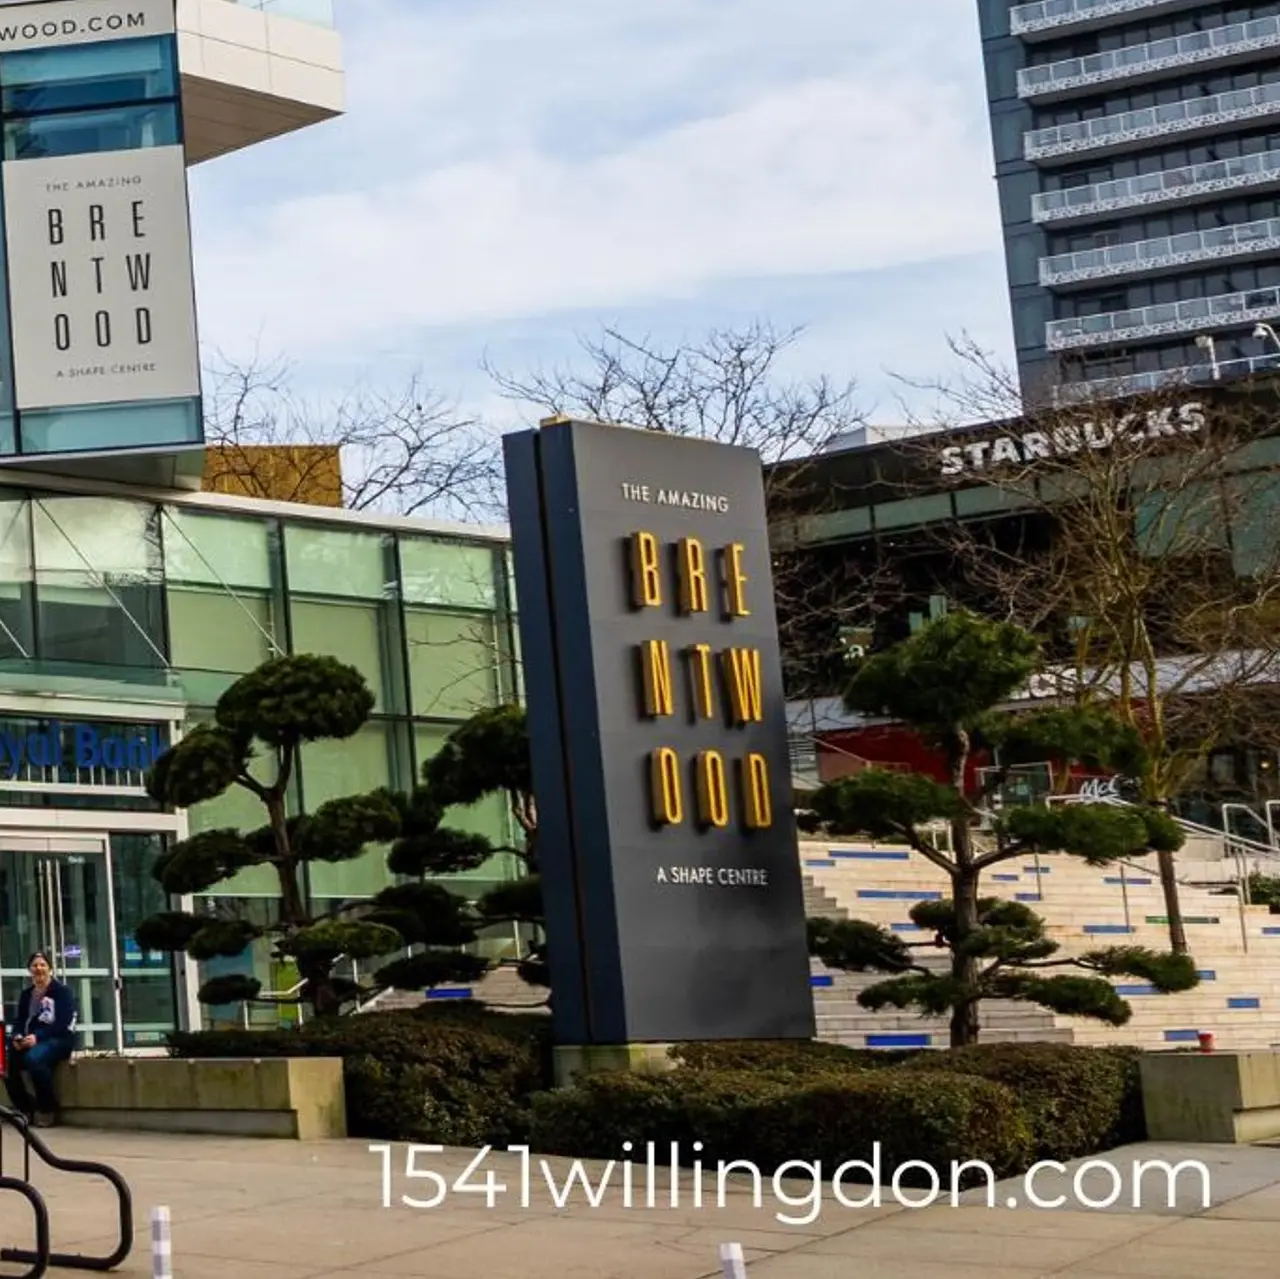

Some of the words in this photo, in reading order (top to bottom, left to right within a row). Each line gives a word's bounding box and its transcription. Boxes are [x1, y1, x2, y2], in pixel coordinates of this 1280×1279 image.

[76, 175, 142, 190] AMAZING
[69, 366, 106, 378] SHAPE
[940, 401, 1206, 476] STARBUCKS
[622, 482, 651, 502] THE
[657, 489, 730, 513] AMAZING
[657, 866, 668, 884] A
[671, 866, 714, 886] SHAPE
[717, 867, 769, 886] CENTRE
